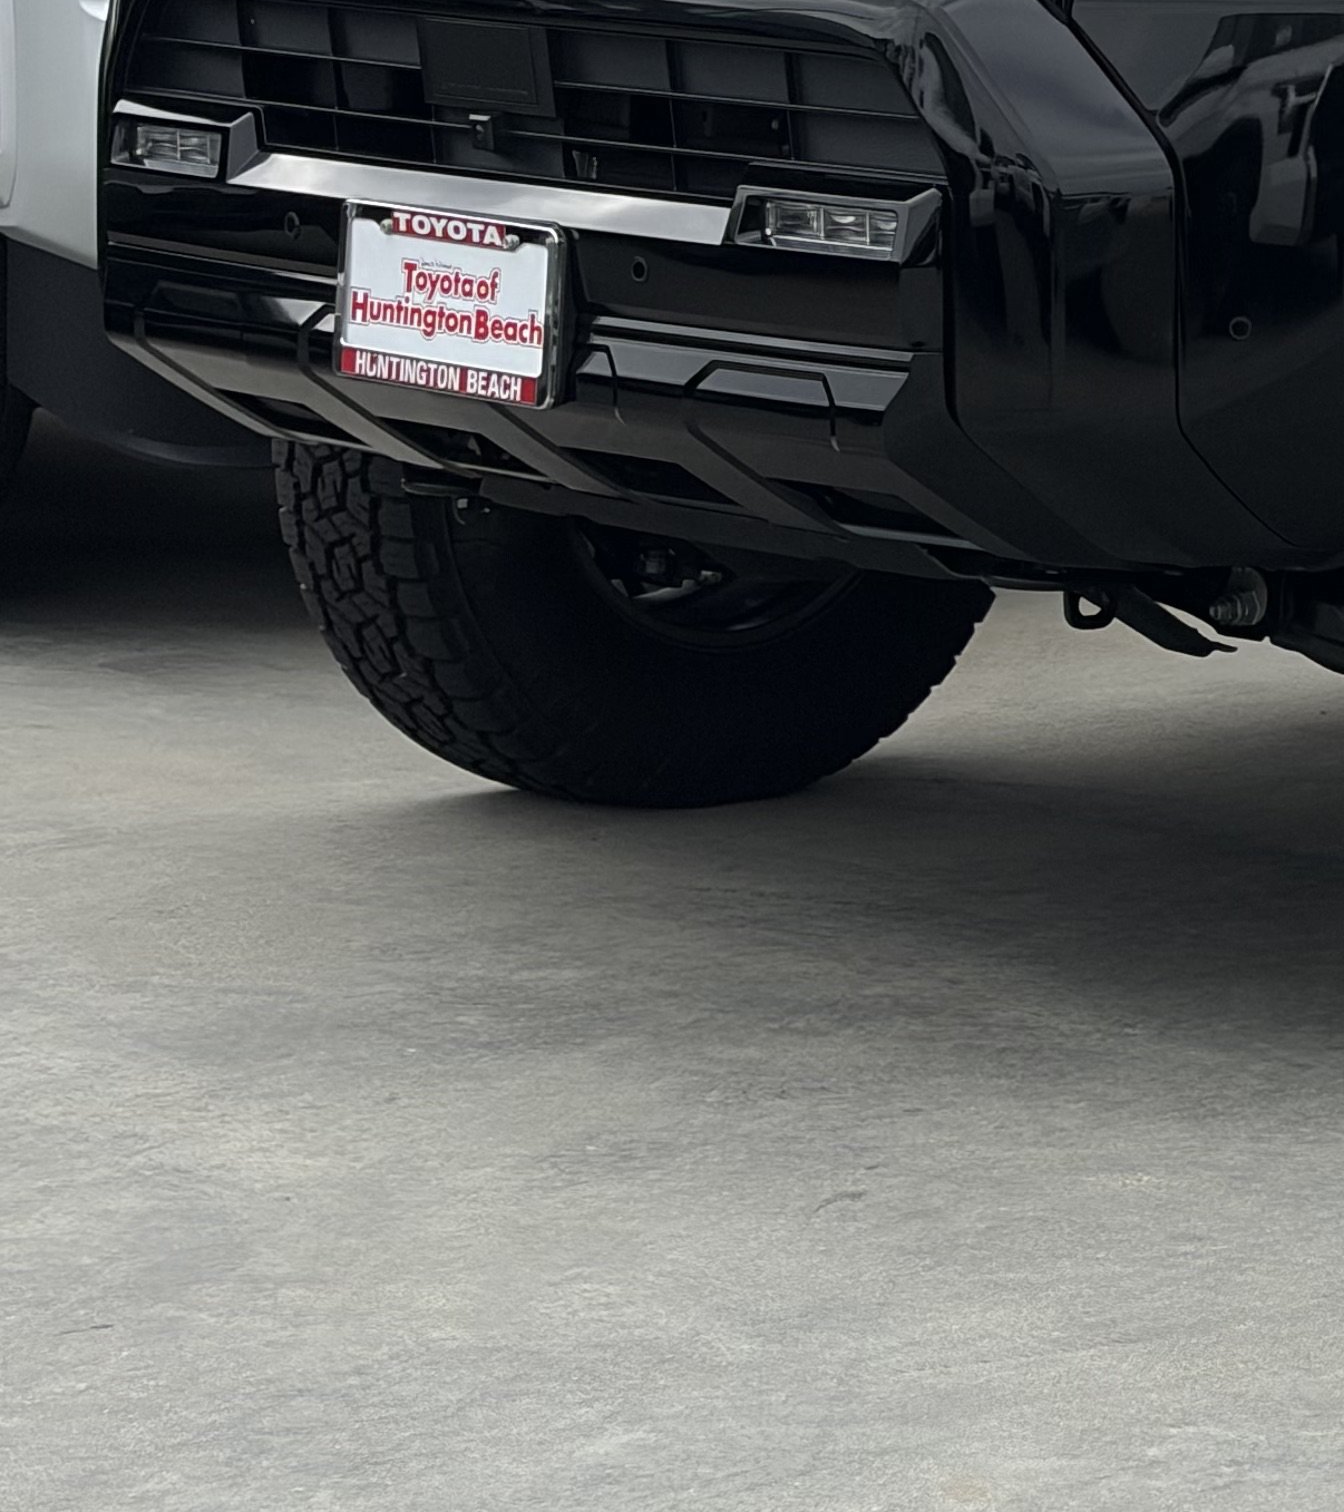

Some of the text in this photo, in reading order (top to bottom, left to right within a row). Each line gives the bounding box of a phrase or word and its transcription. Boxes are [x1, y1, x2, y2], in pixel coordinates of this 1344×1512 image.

[393, 211, 503, 248] TOYOTA
[404, 262, 499, 303] Toyota of
[351, 290, 543, 346] Huntington Beach
[354, 350, 522, 402] HUNTINGTON BEACH
